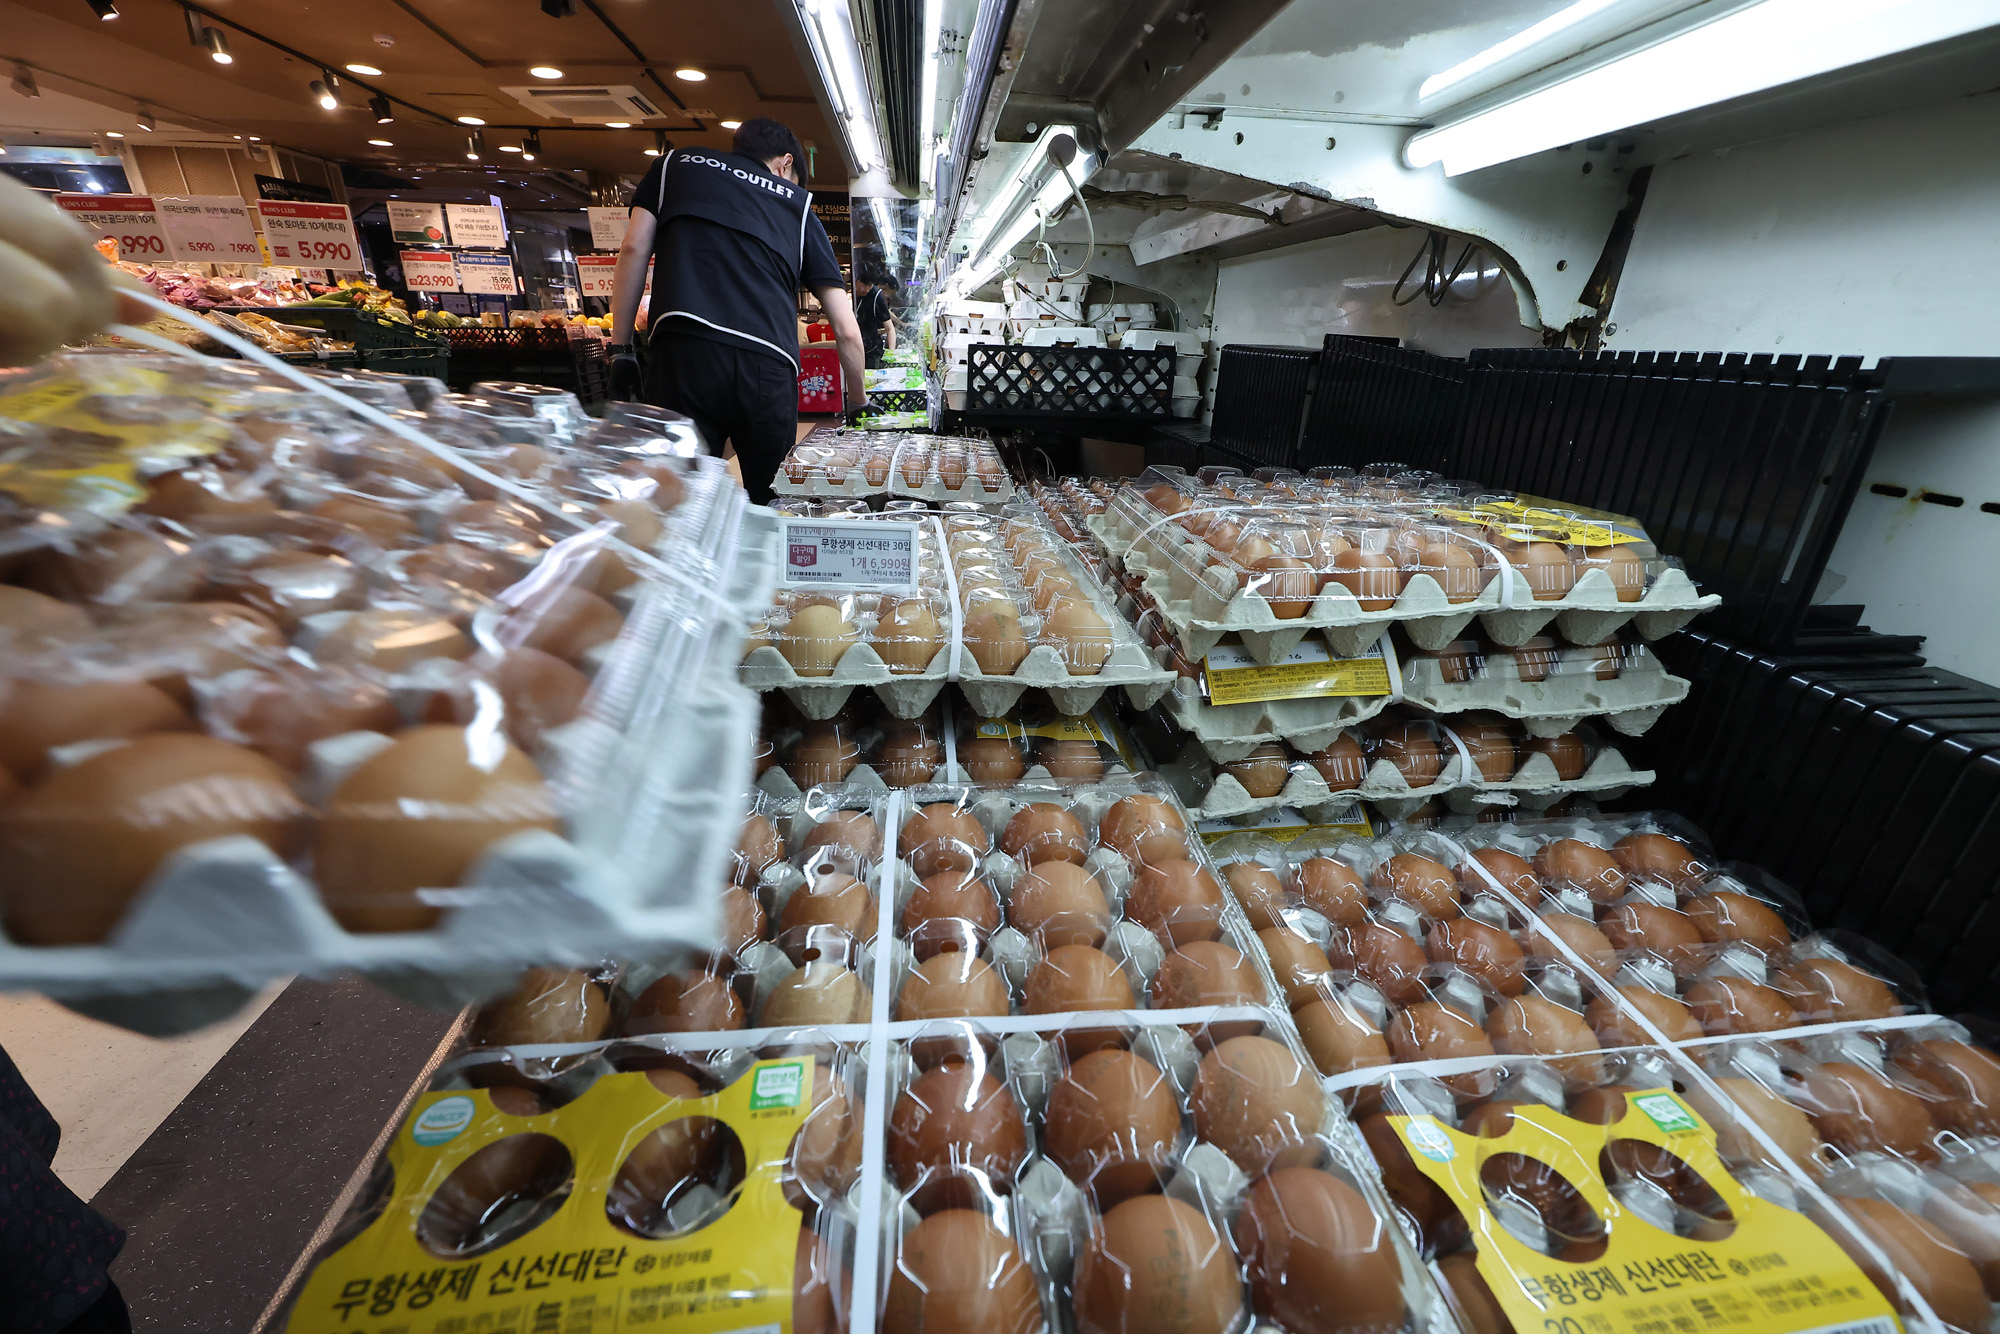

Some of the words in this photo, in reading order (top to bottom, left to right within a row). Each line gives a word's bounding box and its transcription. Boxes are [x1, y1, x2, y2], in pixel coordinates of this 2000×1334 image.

[267, 219, 284, 228] 완숙
[284, 220, 307, 230] 토마토
[104, 235, 165, 255] ,990
[417, 275, 454, 287] 23,990
[792, 546, 814, 554] 다구매
[821, 538, 855, 550] 무항생제
[856, 541, 890, 551] 신선대란
[892, 541, 911, 551] 30입
[796, 555, 811, 564] 할인
[851, 557, 867, 569] 1개
[870, 558, 910, 570] 6,990원
[332, 1263, 481, 1322] 무항생제
[488, 1246, 629, 1297] 신선대란
[1520, 1265, 1628, 1310] 무항생제
[1623, 1250, 1727, 1293] 신선대란
